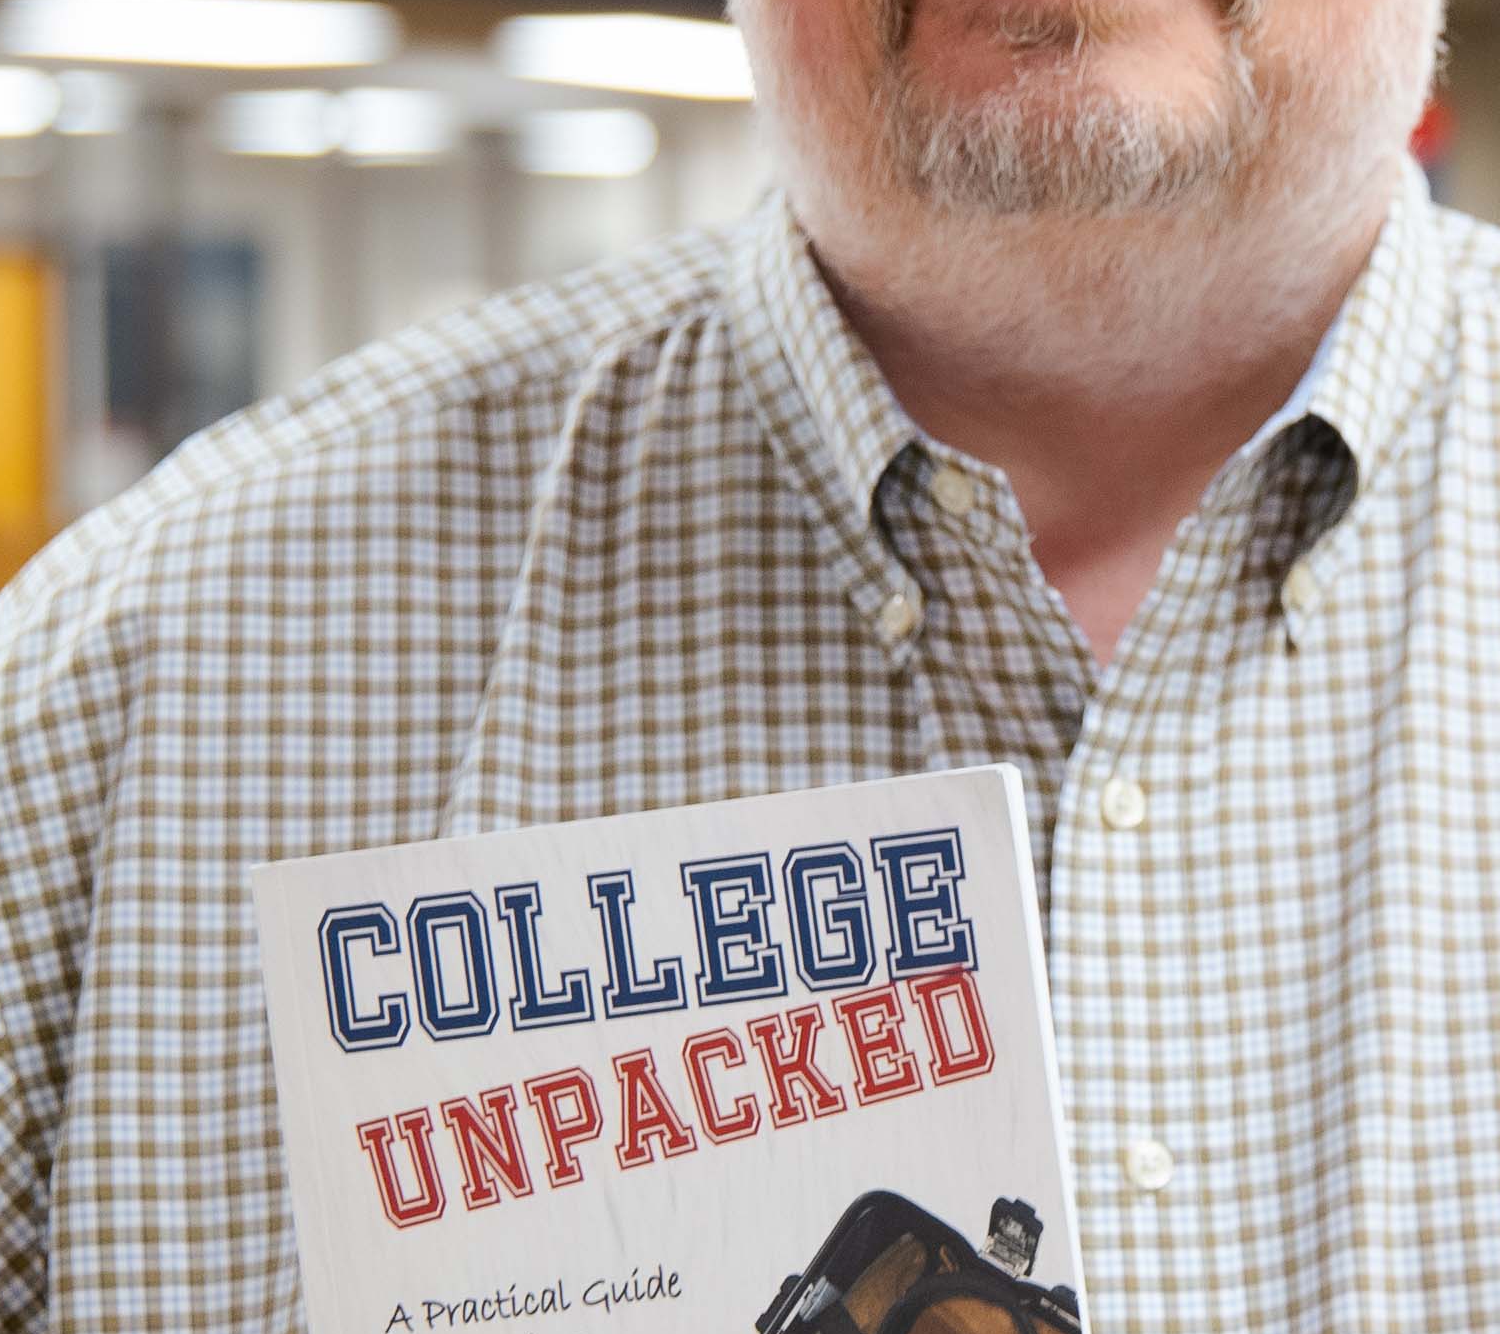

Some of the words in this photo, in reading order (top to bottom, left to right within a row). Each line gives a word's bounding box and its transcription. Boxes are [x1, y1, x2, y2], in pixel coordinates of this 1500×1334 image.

[318, 827, 979, 1054] COLLEGE
[356, 968, 996, 1230] UNPACKED
[385, 1303, 414, 1334] A
[422, 1278, 571, 1329] Practical
[582, 1264, 682, 1314] Guide
